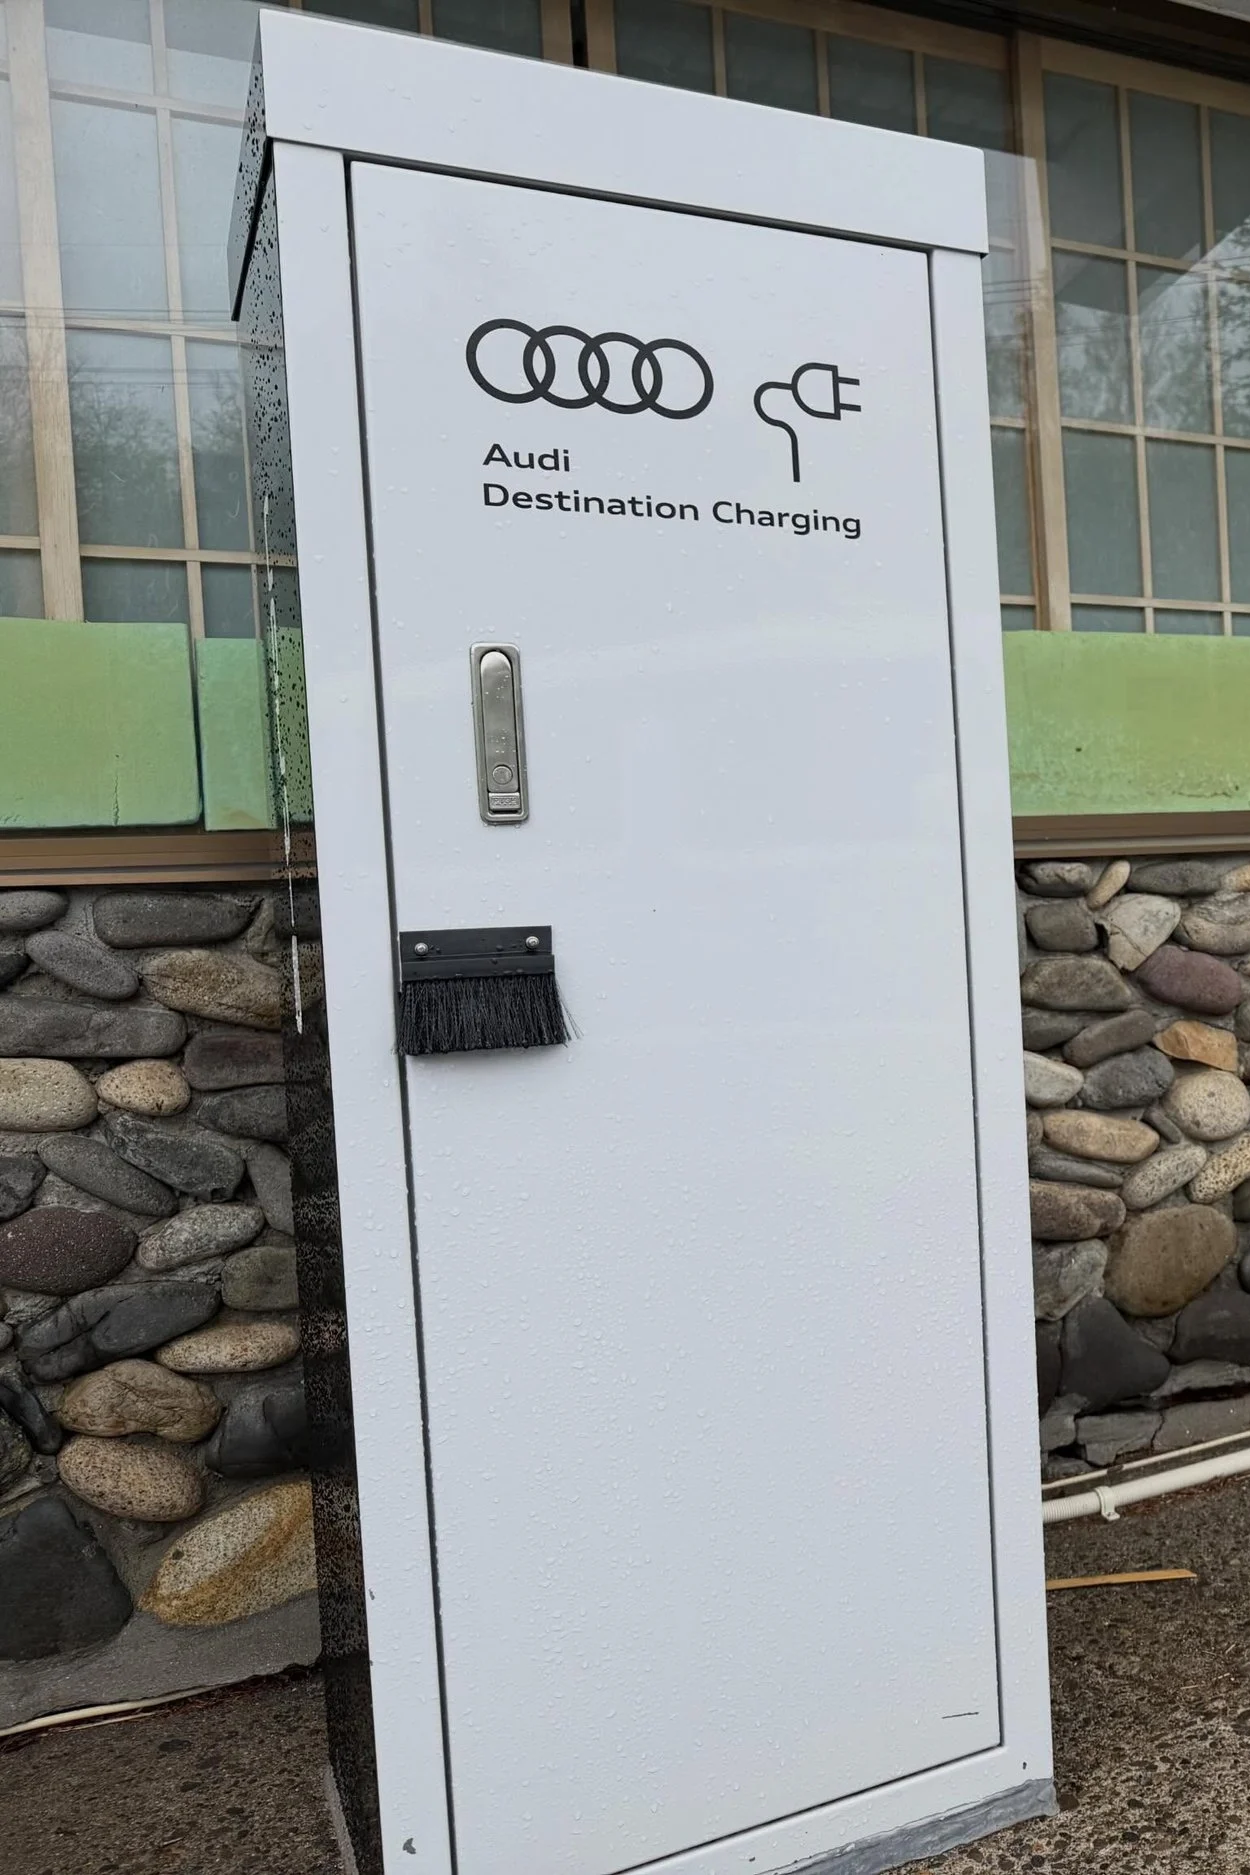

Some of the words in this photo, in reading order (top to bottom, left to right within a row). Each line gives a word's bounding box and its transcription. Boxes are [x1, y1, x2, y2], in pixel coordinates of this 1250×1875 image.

[482, 443, 571, 473] Audi
[482, 482, 700, 521] Destination
[711, 500, 862, 540] Charging
